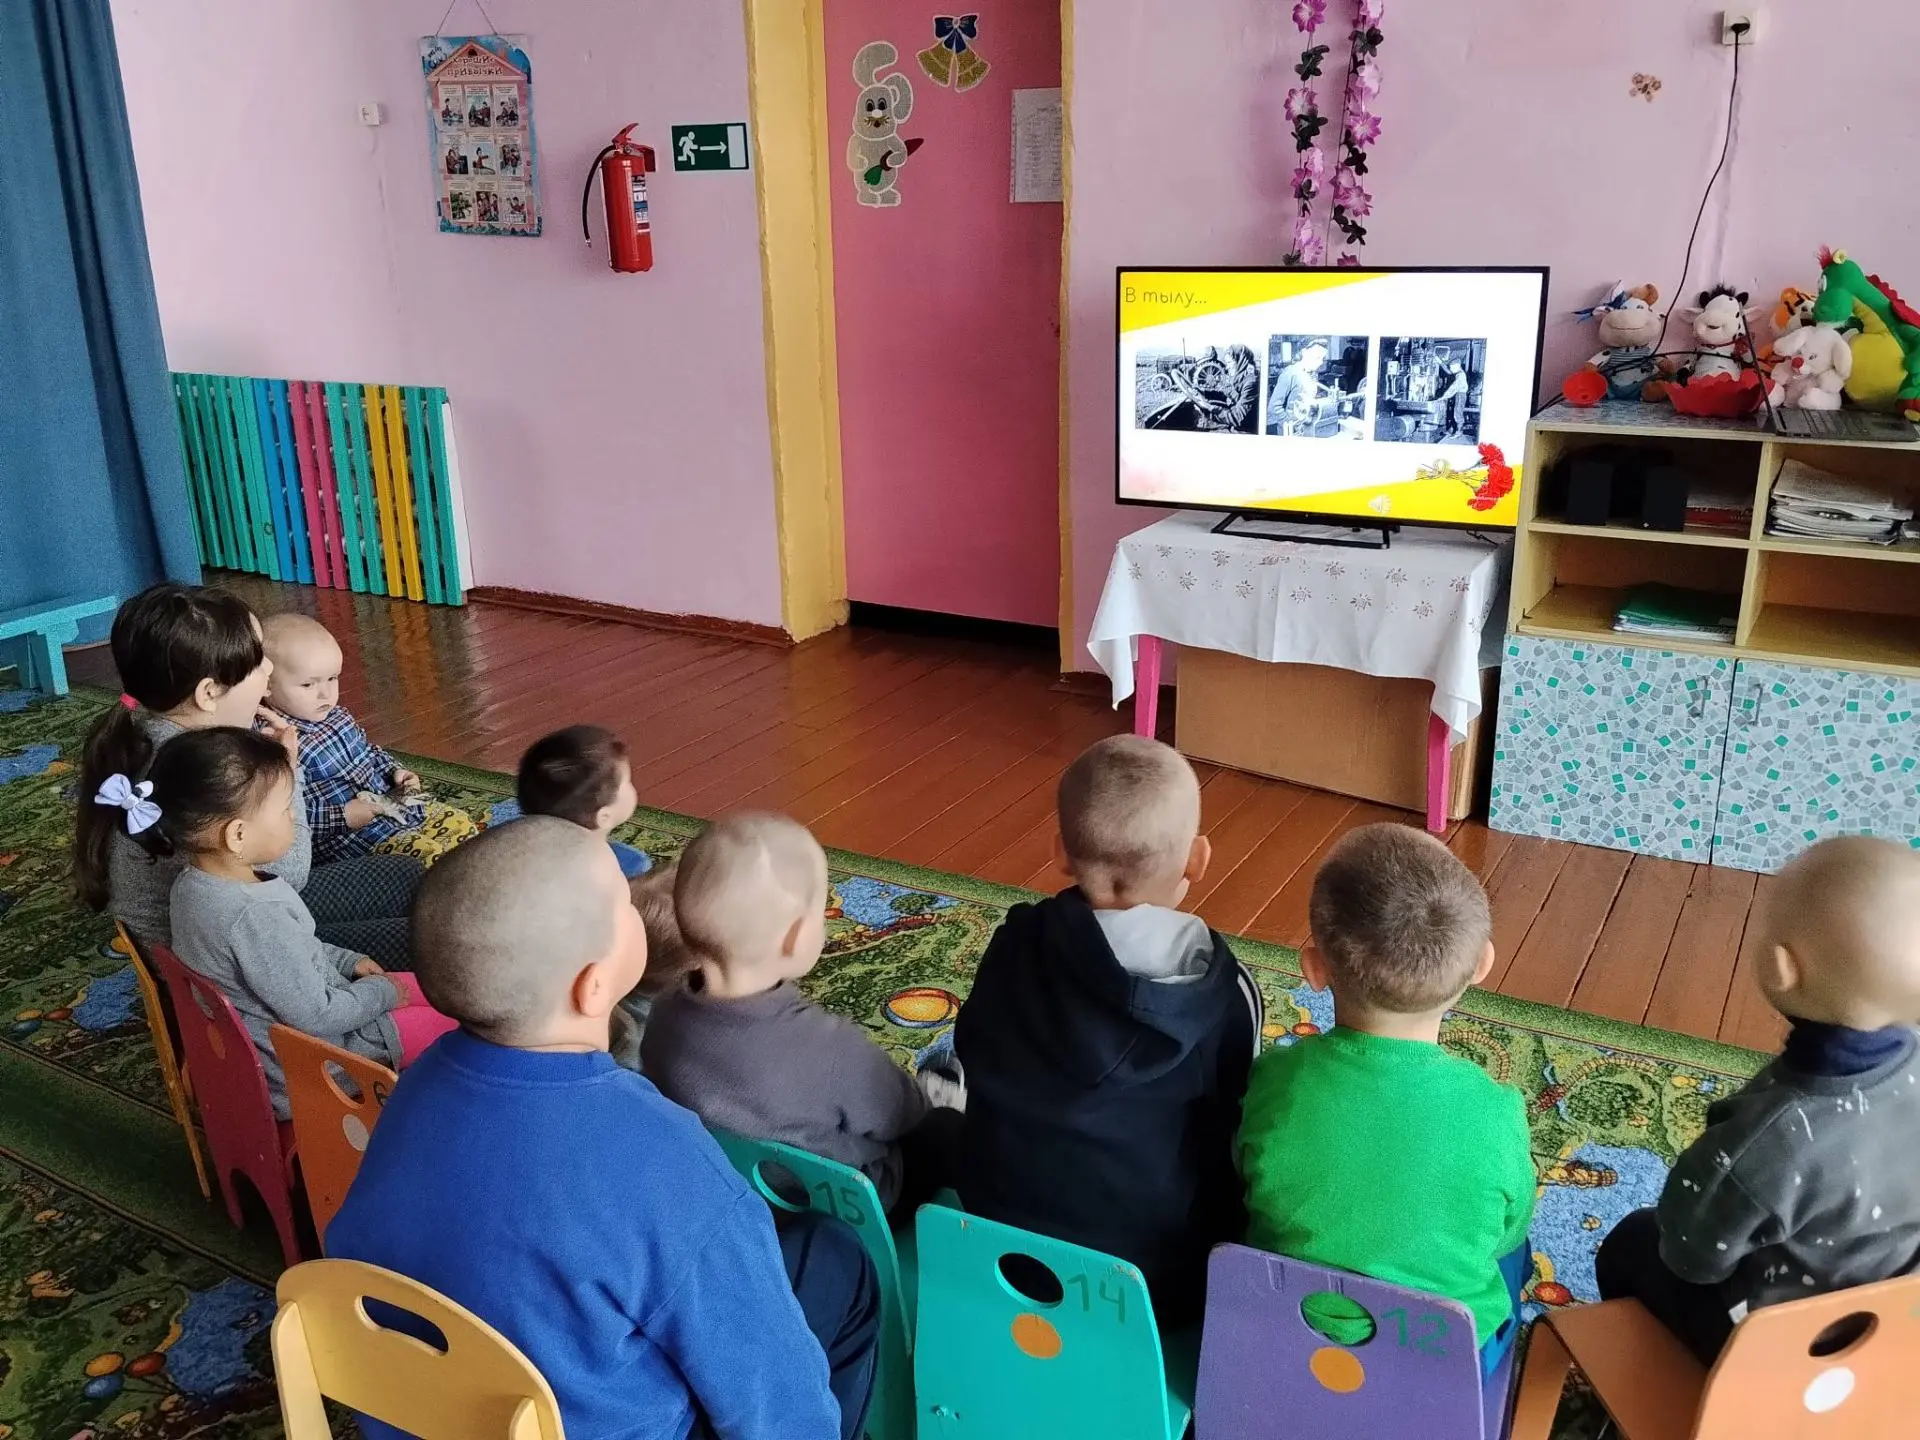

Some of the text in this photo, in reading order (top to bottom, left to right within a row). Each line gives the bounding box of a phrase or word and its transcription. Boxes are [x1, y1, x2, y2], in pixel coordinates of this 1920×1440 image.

[1125, 286, 1207, 309] В тылу...
[814, 1181, 866, 1226] 15
[1066, 1273, 1126, 1324] 14
[1381, 1306, 1449, 1356] 12
